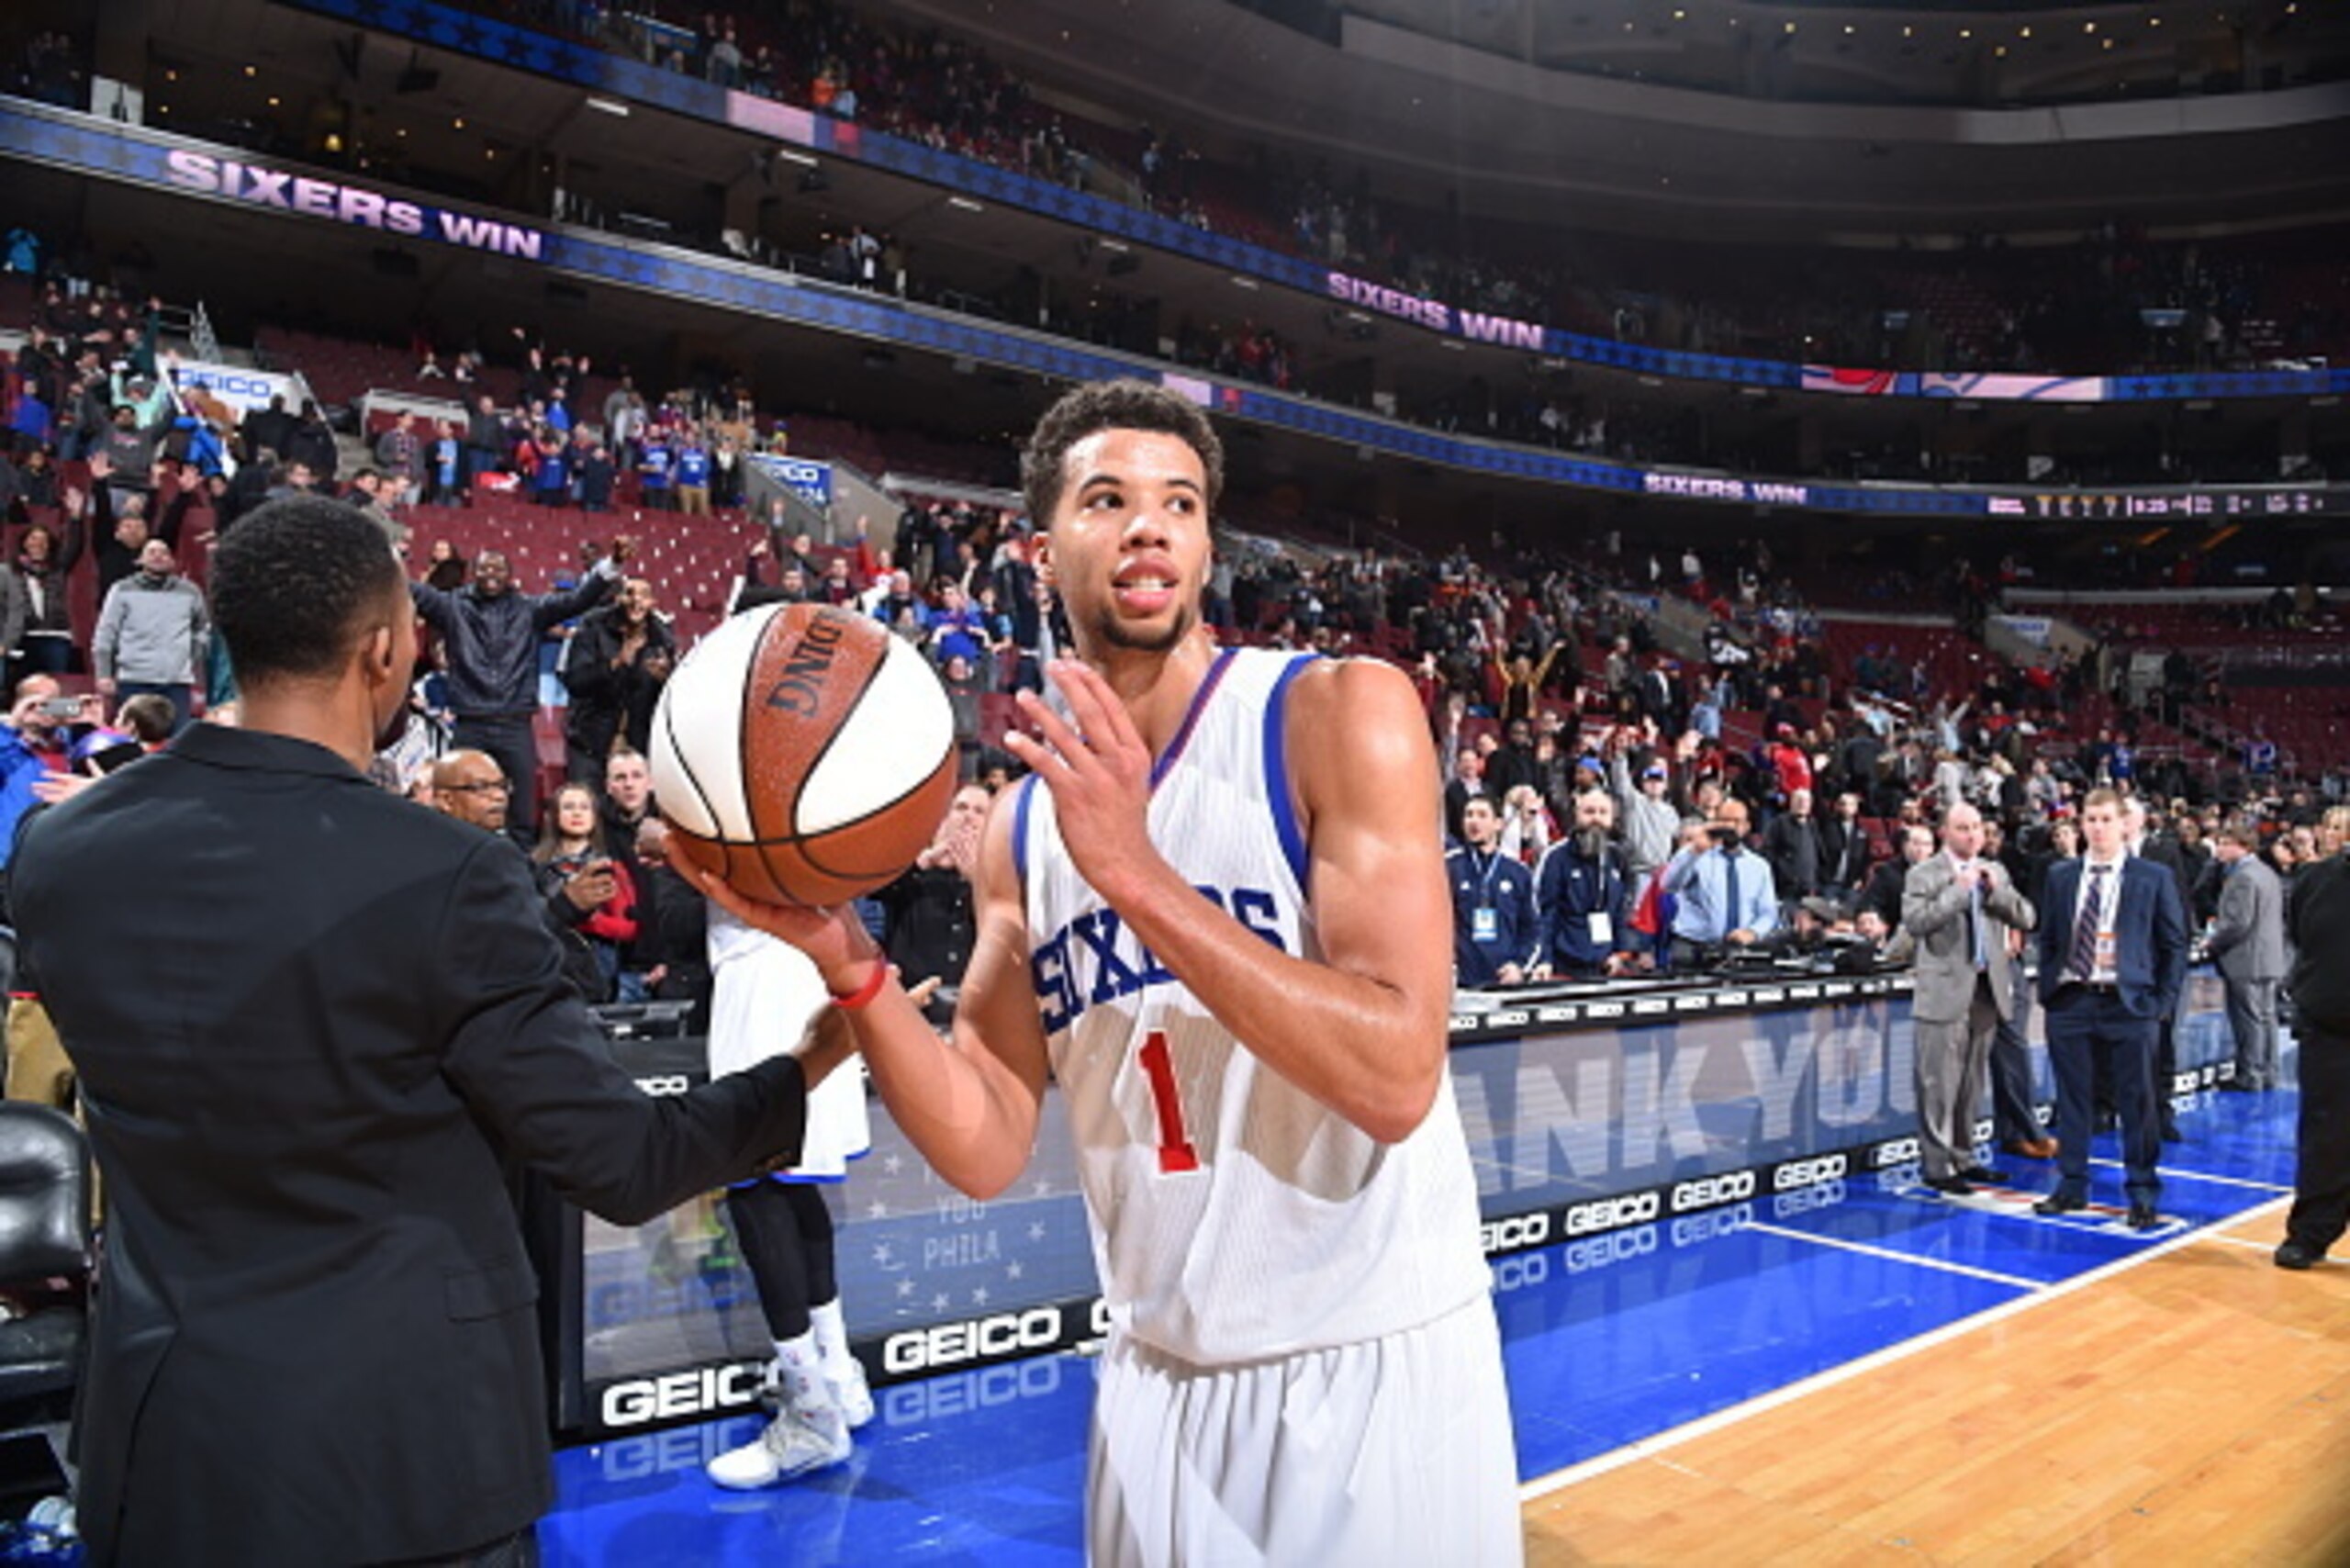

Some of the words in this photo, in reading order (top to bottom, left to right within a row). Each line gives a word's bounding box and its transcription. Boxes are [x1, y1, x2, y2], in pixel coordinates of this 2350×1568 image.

[168, 150, 422, 235] SIXERS
[439, 211, 542, 260] WIN
[1327, 272, 1449, 330] SIXERS
[1459, 309, 1544, 350] WIN
[1643, 472, 1744, 501] SIXERS
[1752, 482, 1807, 505] WIN
[1031, 884, 1287, 1036] SIXS
[1137, 1030, 1200, 1173] 1
[1671, 1170, 1755, 1212] GEICO
[1774, 1153, 1847, 1191] GEICO
[1565, 1191, 1660, 1236] GEICO
[923, 1229, 1002, 1271] PHILA
[884, 1308, 1061, 1374] GEICO
[602, 1362, 778, 1427] GEIC
